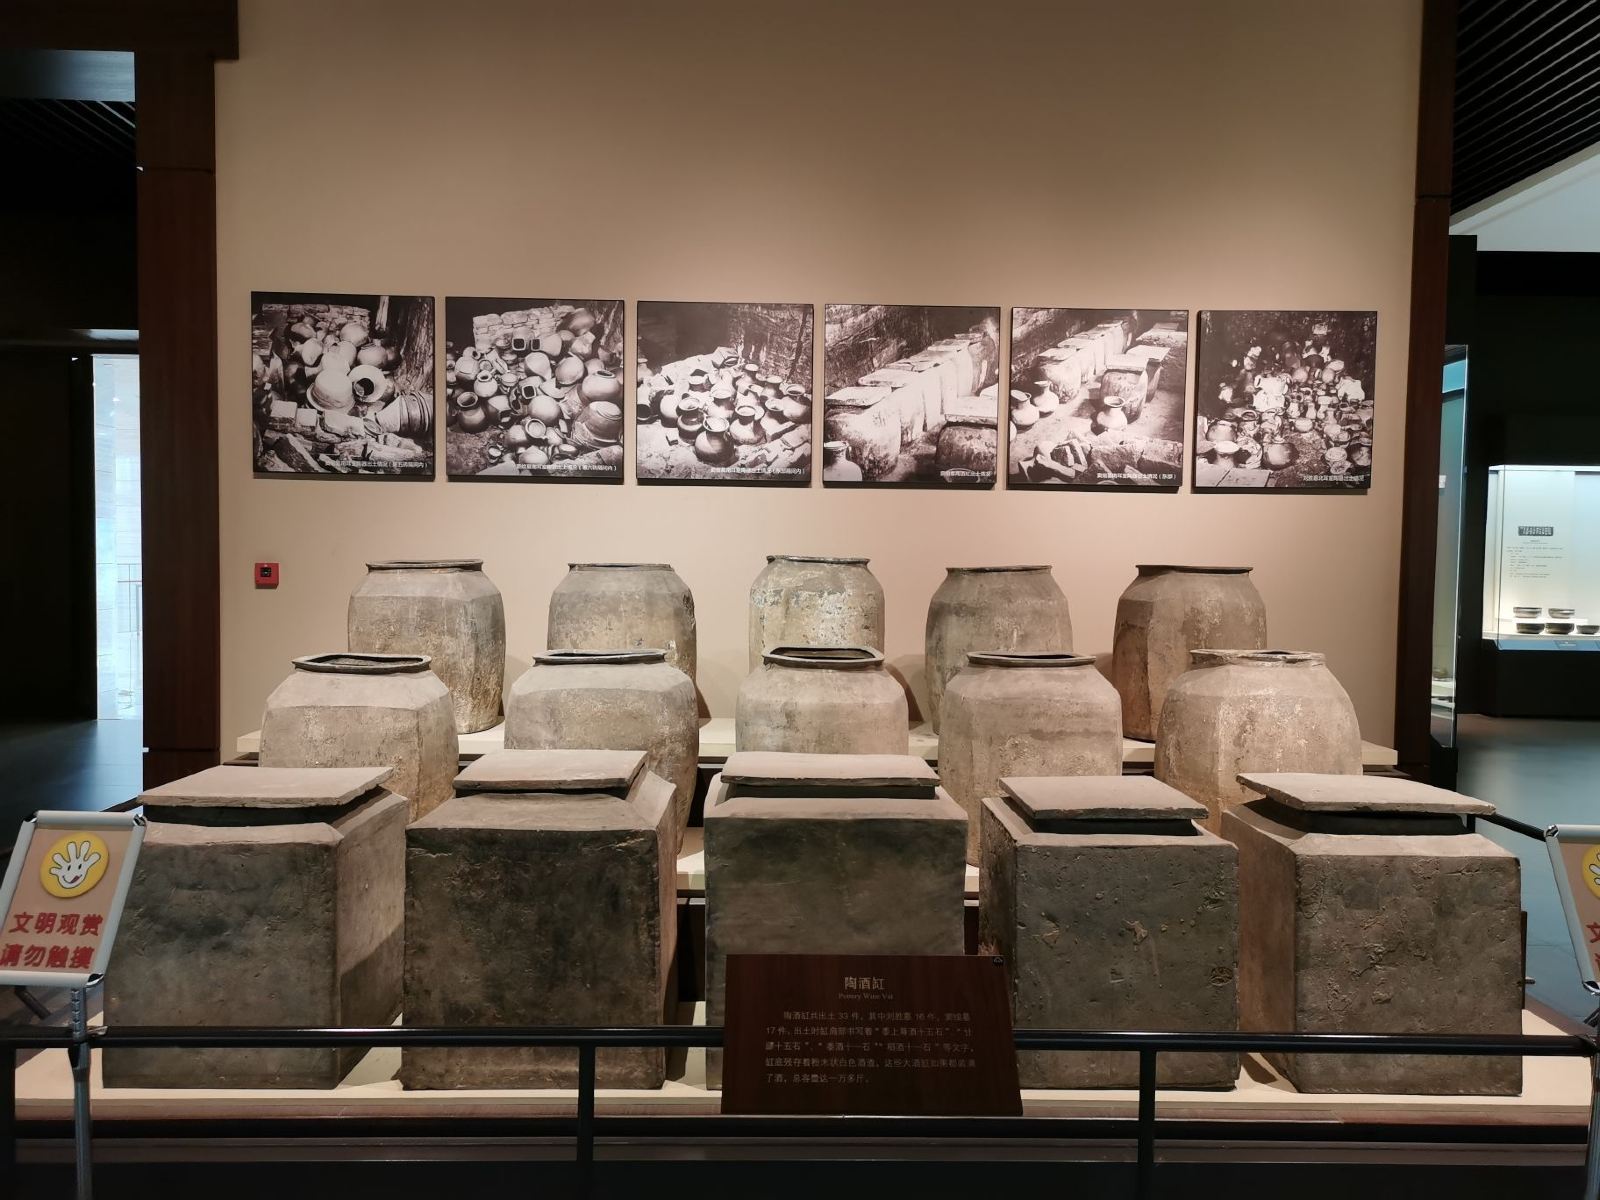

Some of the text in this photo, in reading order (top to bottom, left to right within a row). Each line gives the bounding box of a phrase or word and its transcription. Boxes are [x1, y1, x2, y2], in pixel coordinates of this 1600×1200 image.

[8, 912, 104, 936] 文明观赏
[0, 942, 96, 969] 请勿触摸
[844, 976, 886, 990] 陶酒缸
